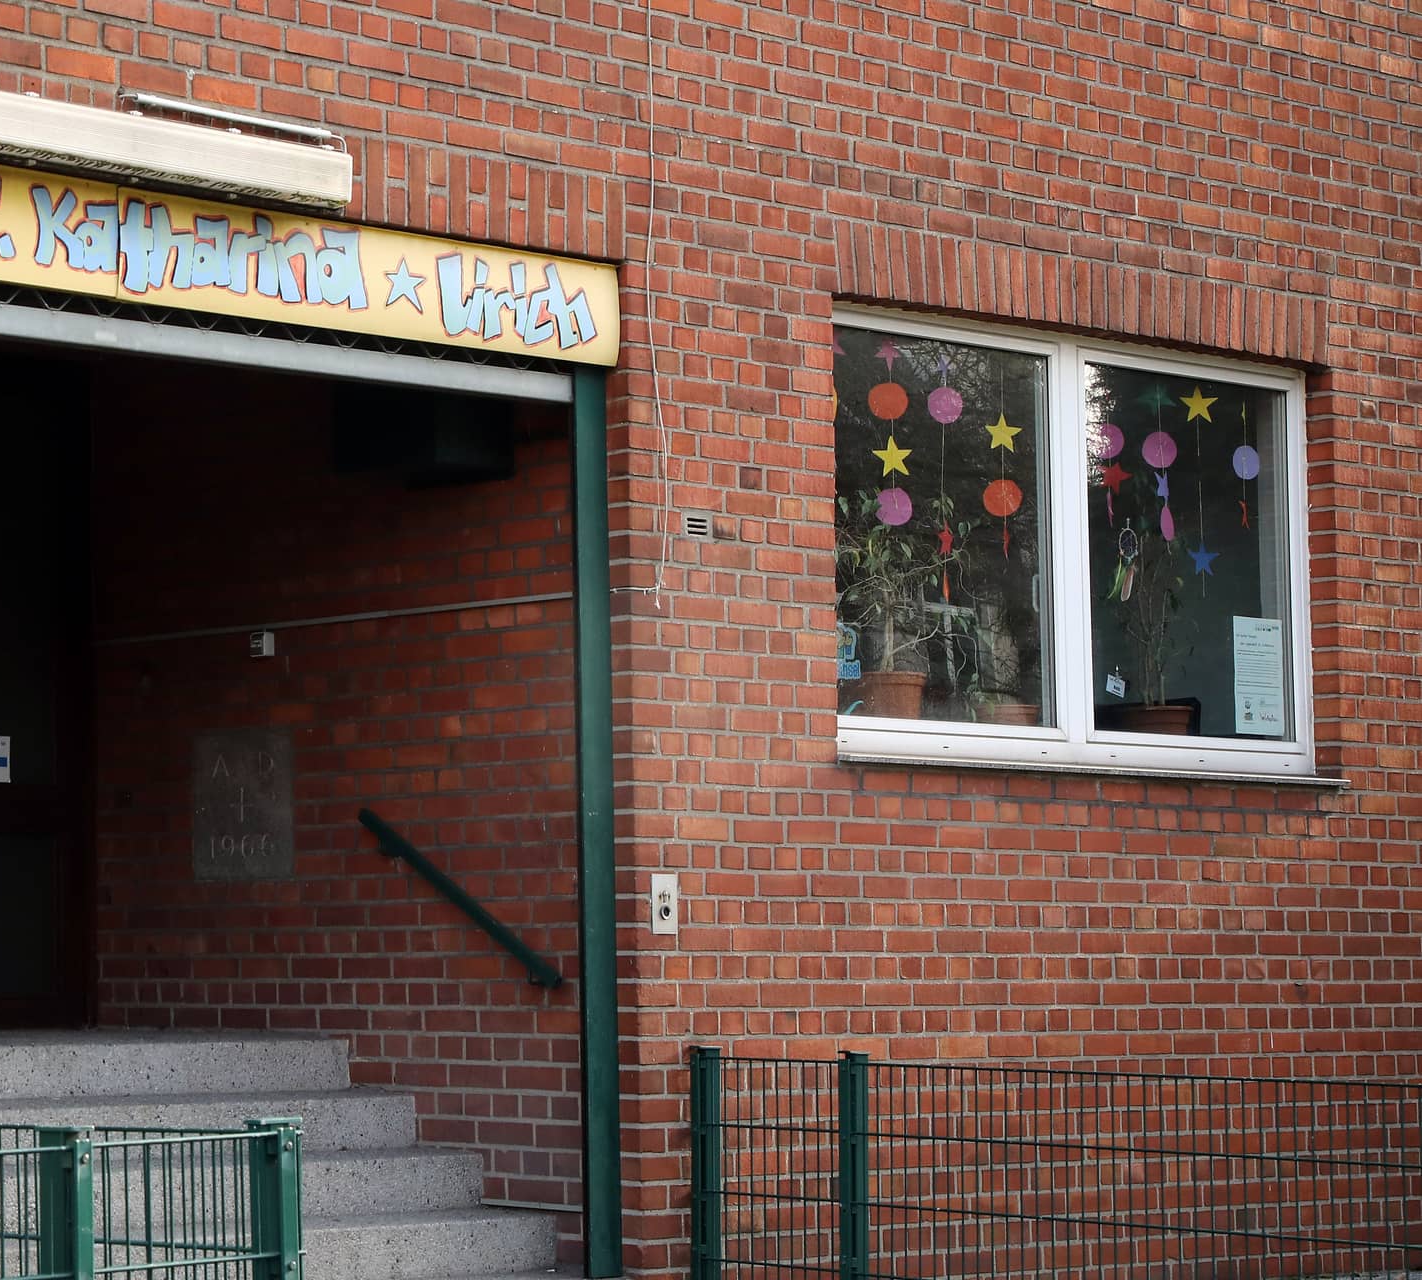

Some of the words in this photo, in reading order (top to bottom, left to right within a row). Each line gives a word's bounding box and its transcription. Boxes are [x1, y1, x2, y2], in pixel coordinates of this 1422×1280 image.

[30, 183, 367, 312] Katharina
[436, 251, 598, 351] Lirich
[212, 754, 229, 778] A
